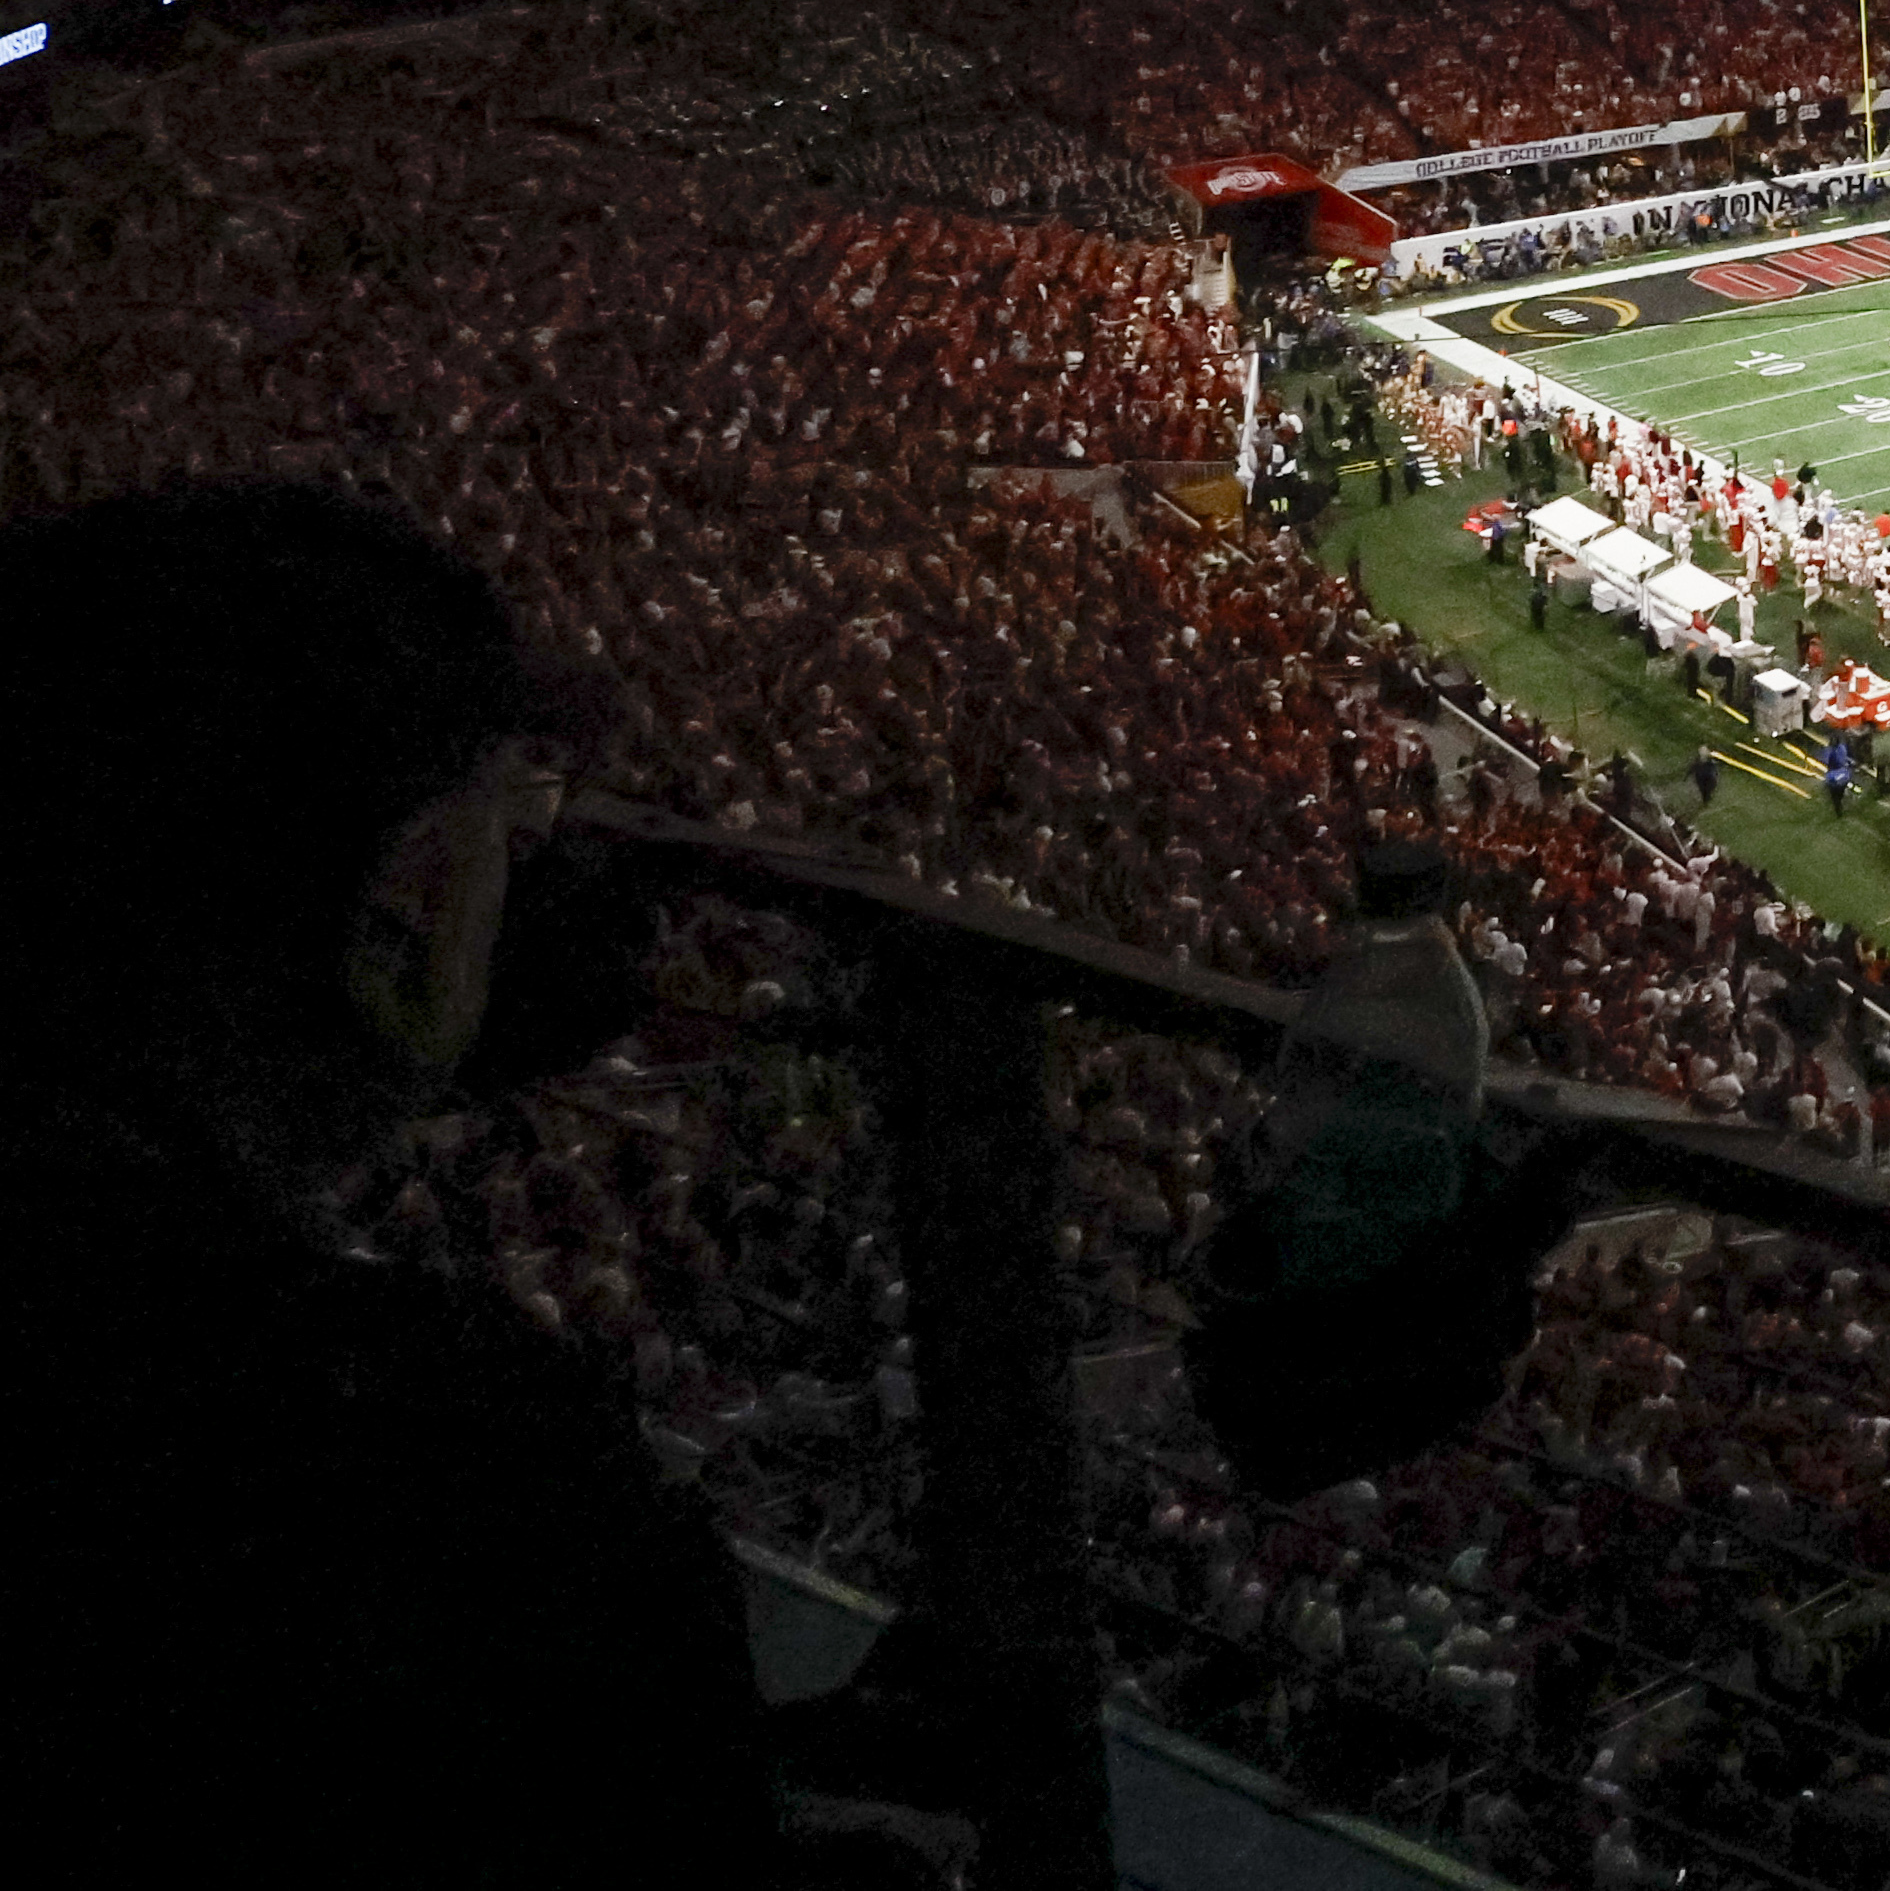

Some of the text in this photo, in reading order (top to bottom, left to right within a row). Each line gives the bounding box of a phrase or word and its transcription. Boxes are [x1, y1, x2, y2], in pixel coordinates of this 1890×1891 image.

[1416, 130, 1658, 178] COLLEGE FOOTBALL PLAYOFF
